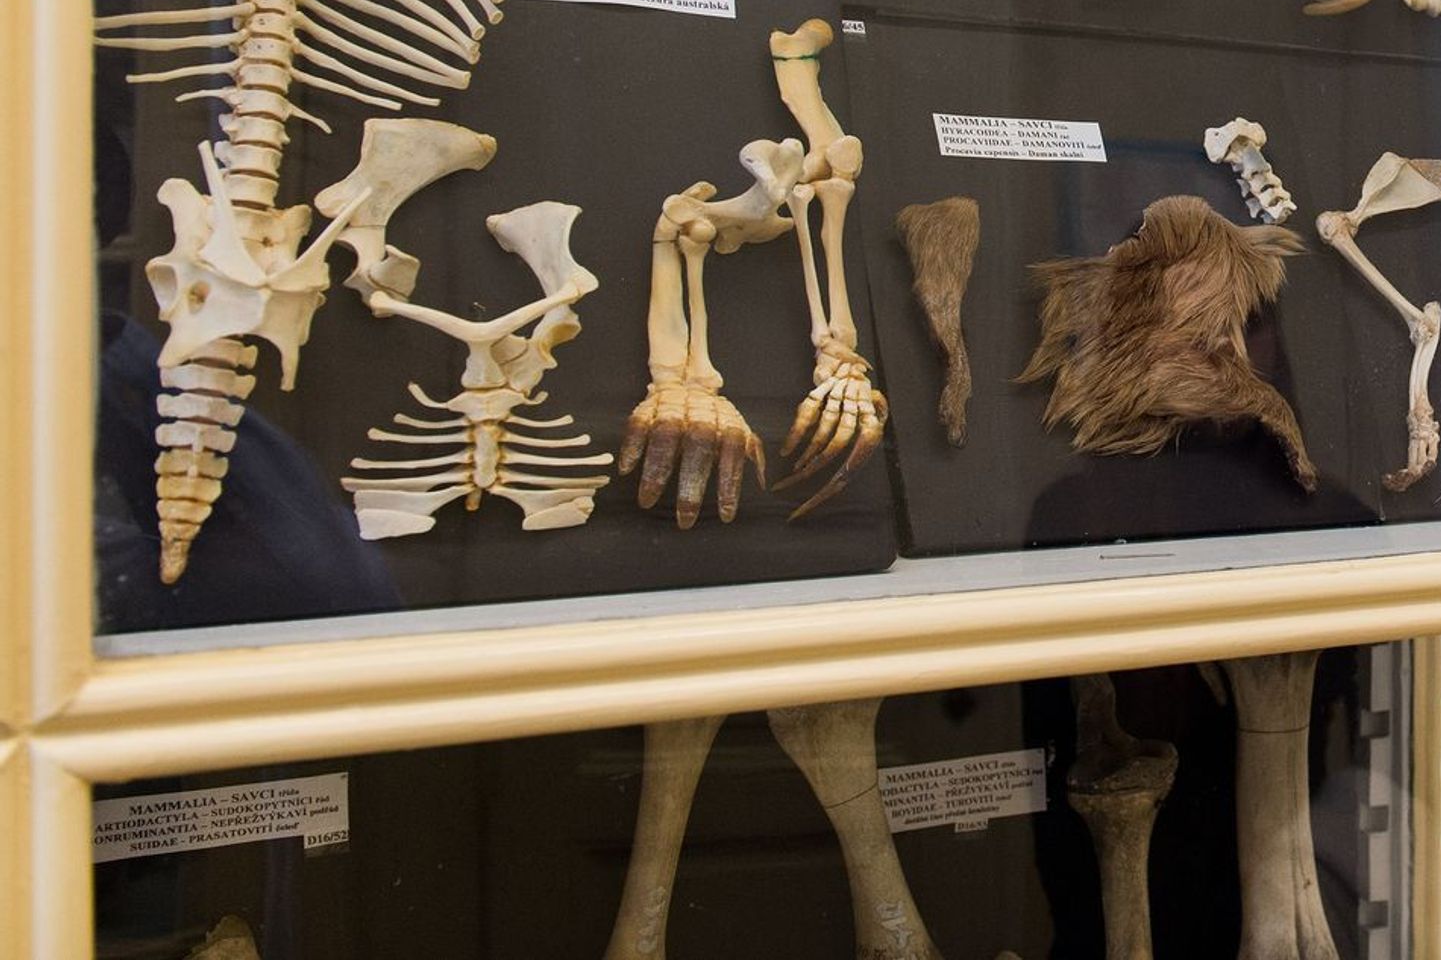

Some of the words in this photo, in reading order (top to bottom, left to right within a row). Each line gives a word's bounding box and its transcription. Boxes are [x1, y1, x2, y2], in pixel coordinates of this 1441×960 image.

[939, 116, 1007, 126] MAMMALIA
[1017, 120, 1052, 128] SAVCI
[940, 127, 1008, 136] HYRACOIDEA
[942, 136, 1011, 145] PROCAVIIDAE
[886, 767, 953, 783] MAMMALIA
[964, 761, 997, 772] SAVCI
[130, 796, 216, 816] MAMMALIA
[231, 789, 273, 802] SAVCI
[891, 804, 935, 817] BOVIDAE
[95, 811, 198, 833] ARTIODACTYLA
[210, 795, 311, 817] SUDOKOPYTNÍCI
[211, 806, 305, 829] NEPŘEŽVÝKAVÍ
[129, 837, 176, 852] SUIDAE
[189, 822, 272, 844] PRASATOVITÍ
[307, 829, 348, 847] D16/52
